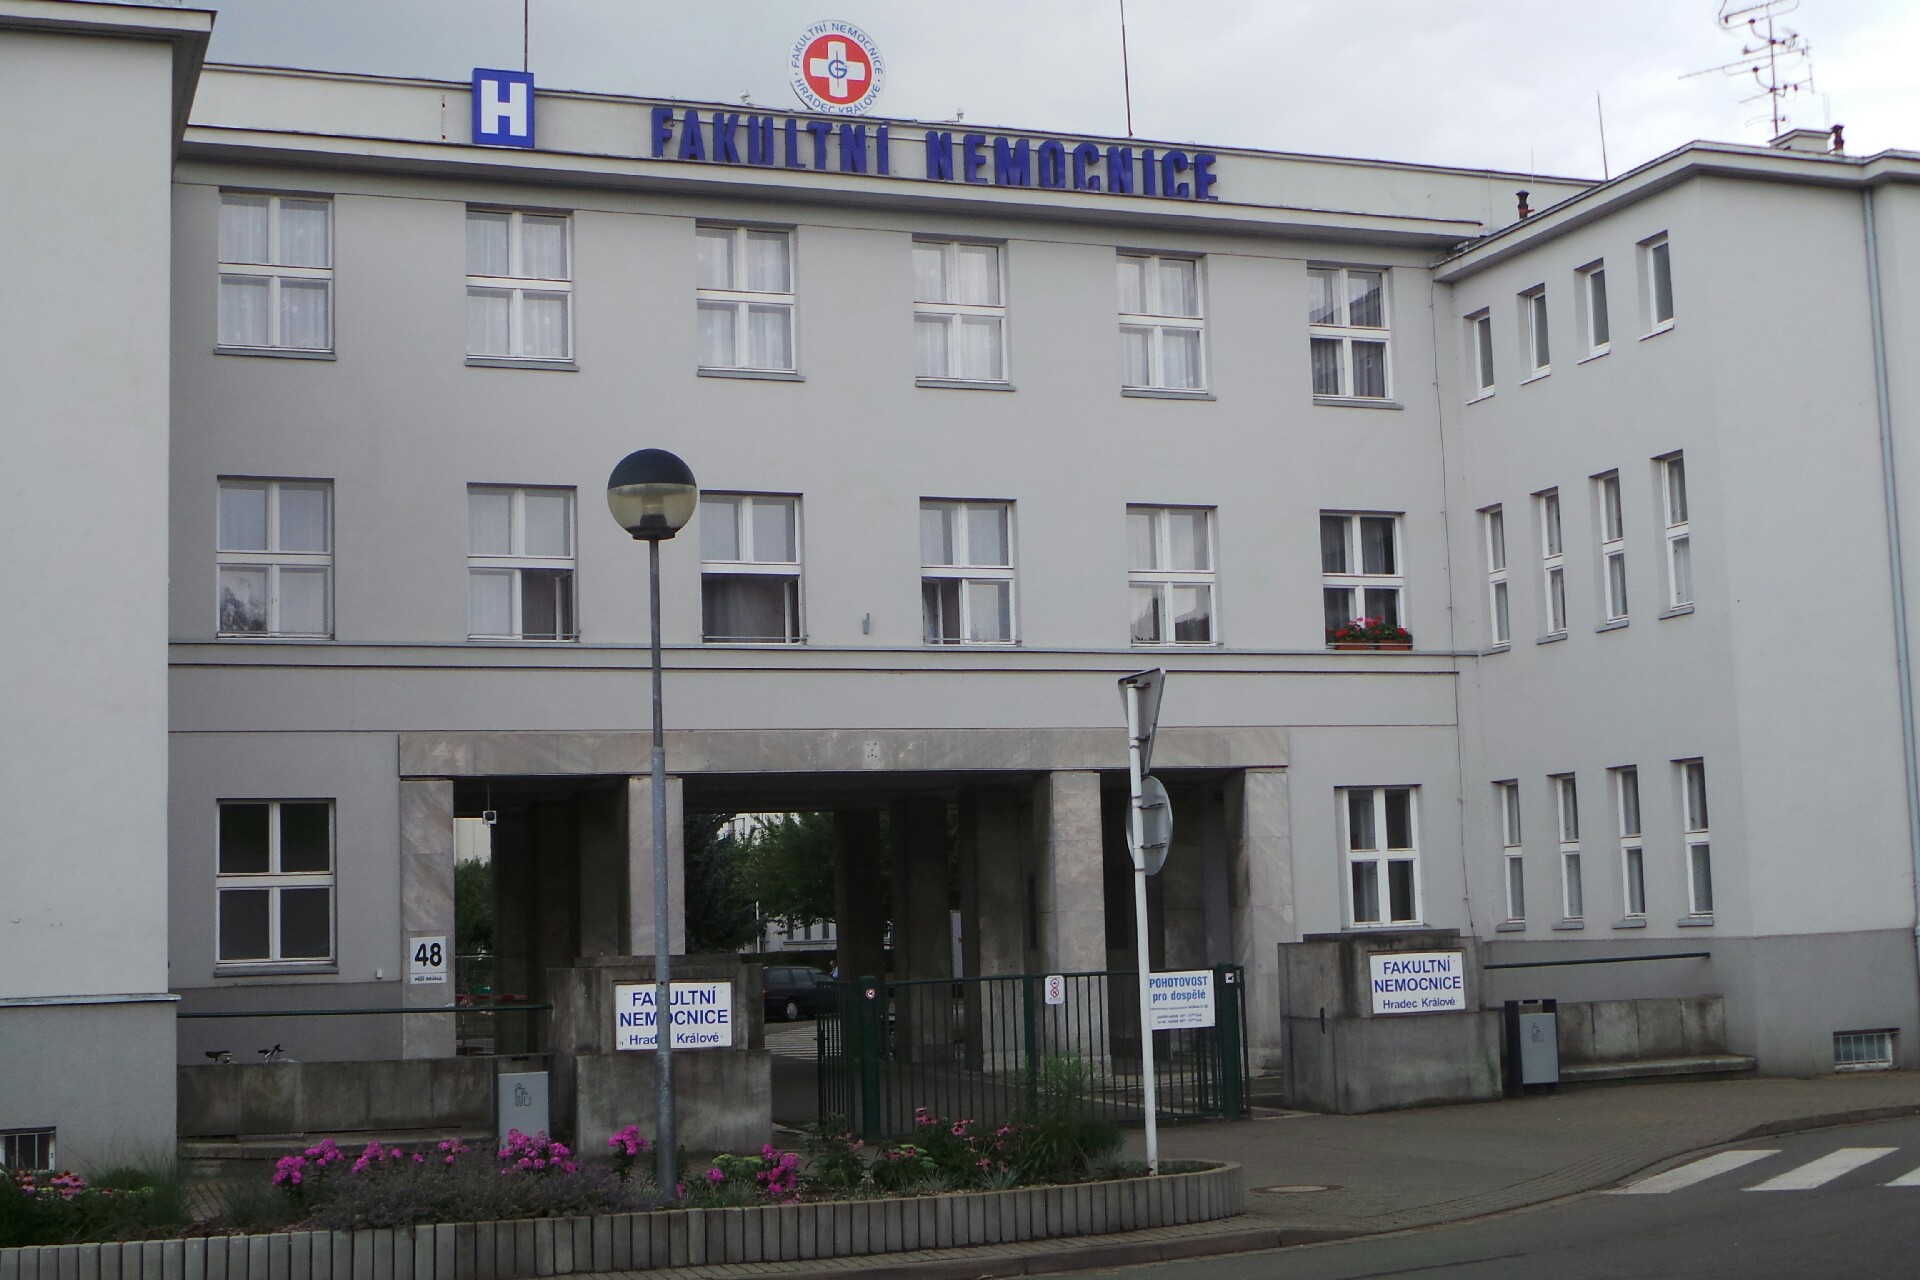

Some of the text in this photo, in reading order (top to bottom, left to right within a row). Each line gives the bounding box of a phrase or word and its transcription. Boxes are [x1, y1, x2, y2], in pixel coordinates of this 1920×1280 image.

[831, 22, 883, 75] NEMOCNICE
[795, 78, 836, 113] HRADEC
[481, 79, 527, 137] H
[925, 130, 1219, 201] NEMOCNICE
[414, 942, 442, 967] 48
[1383, 955, 1450, 975] FAKULTNÍ
[1149, 976, 1208, 988] POHOTOVOST
[1374, 976, 1461, 993] NEMOCNICE
[632, 986, 716, 1007] FAULTNÍ
[1152, 989, 1206, 1004] pro dospělé
[1383, 997, 1455, 1009] Hradec Králové
[629, 1032, 719, 1046] Hrad Králové
